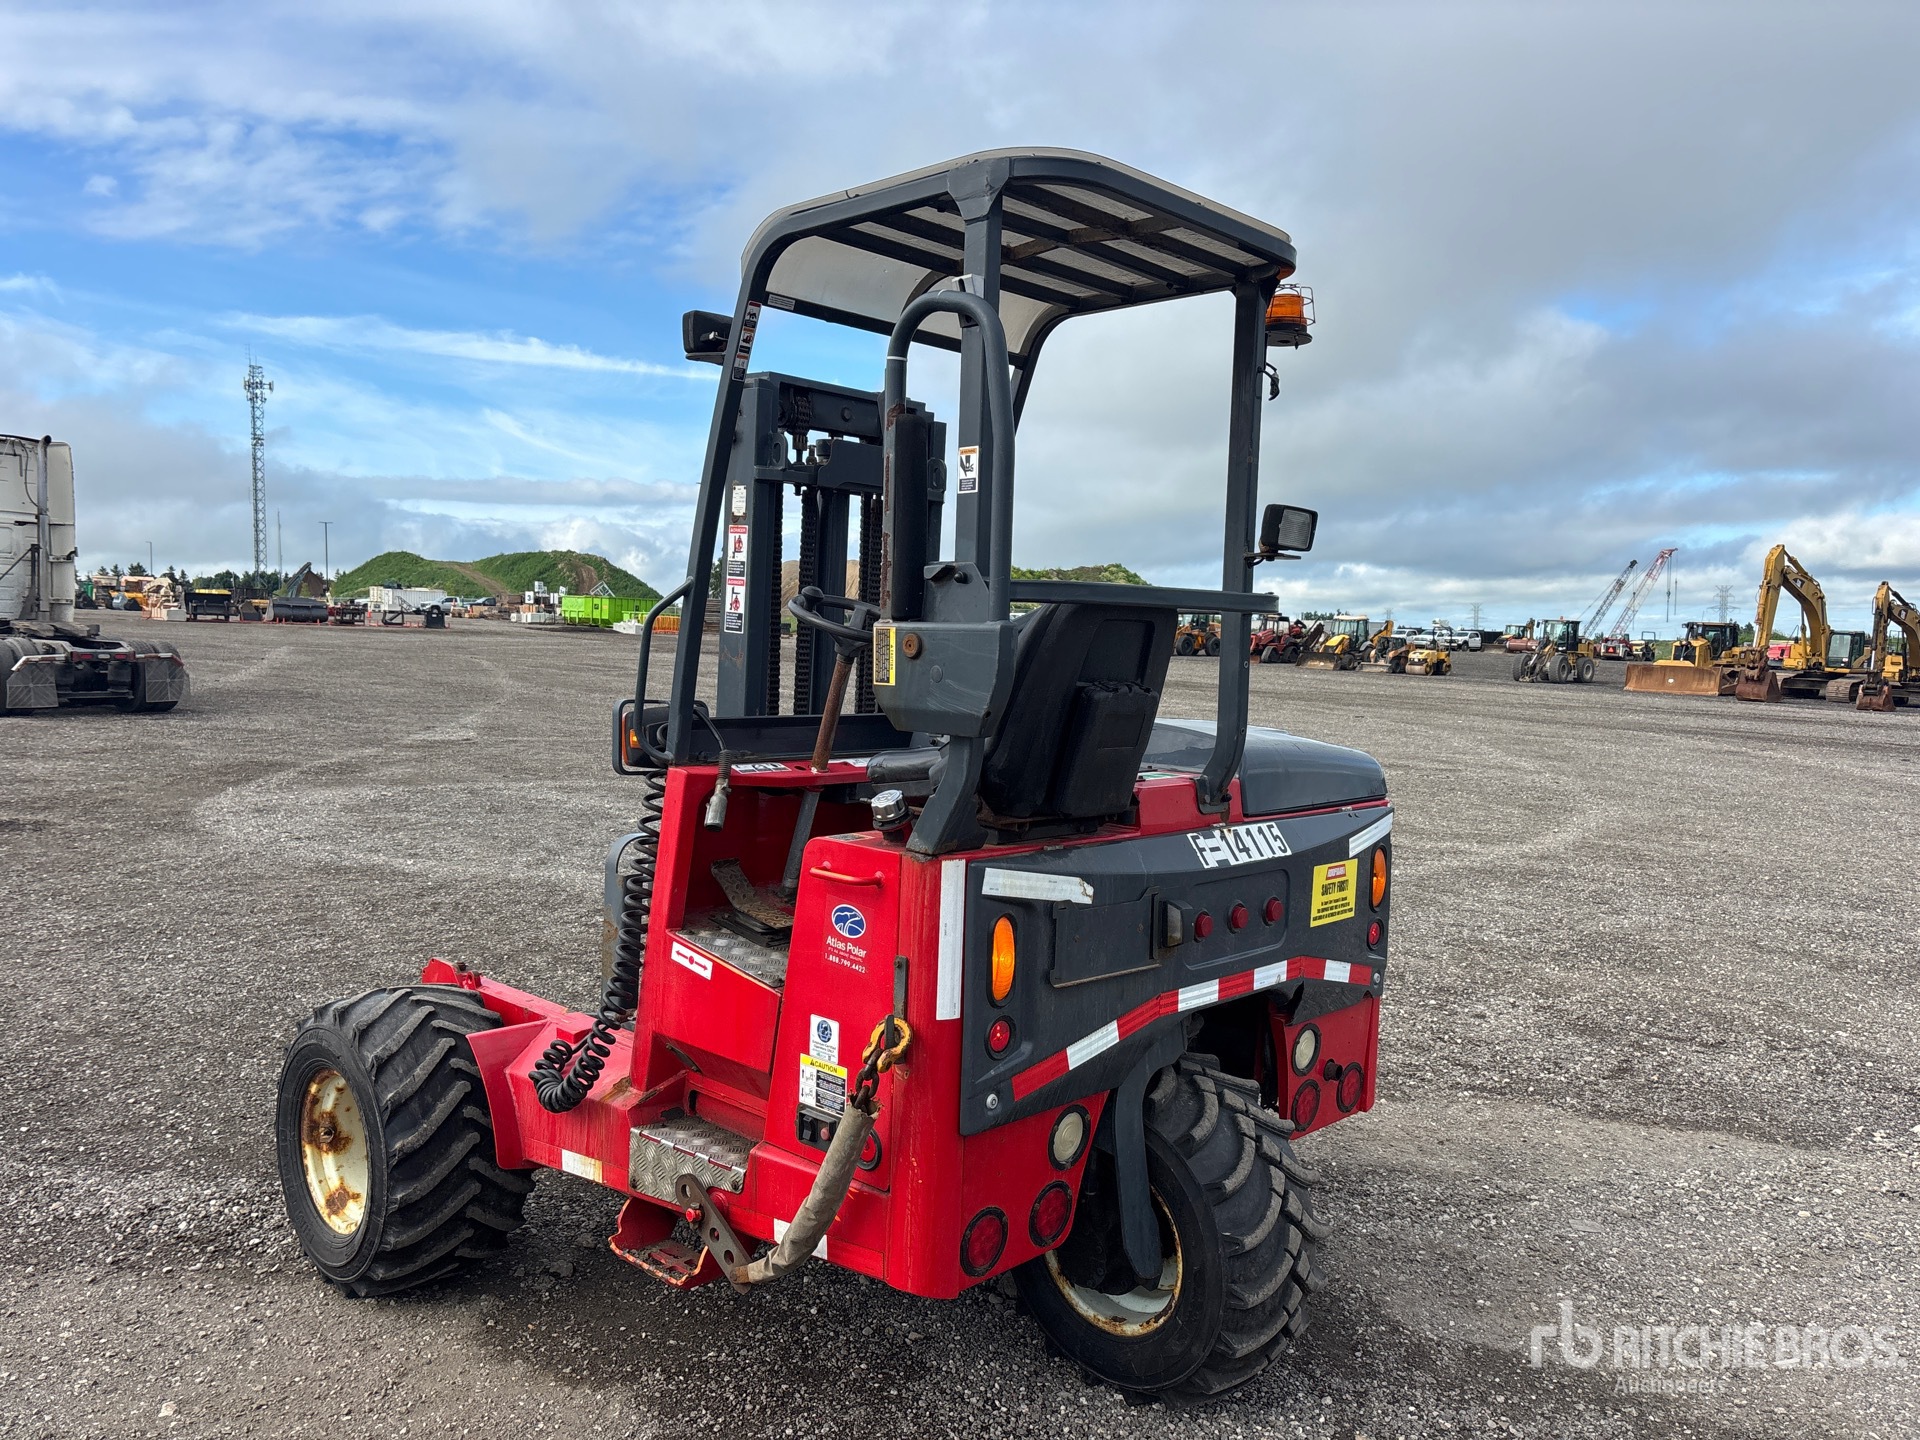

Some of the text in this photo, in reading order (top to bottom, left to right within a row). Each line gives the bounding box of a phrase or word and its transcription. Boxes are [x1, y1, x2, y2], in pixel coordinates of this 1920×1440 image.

[1191, 824, 1288, 867] F-14115
[1321, 882, 1337, 896] SAFETY
[826, 935, 867, 958] Atlas Polar
[814, 1061, 838, 1074] CAUTION
